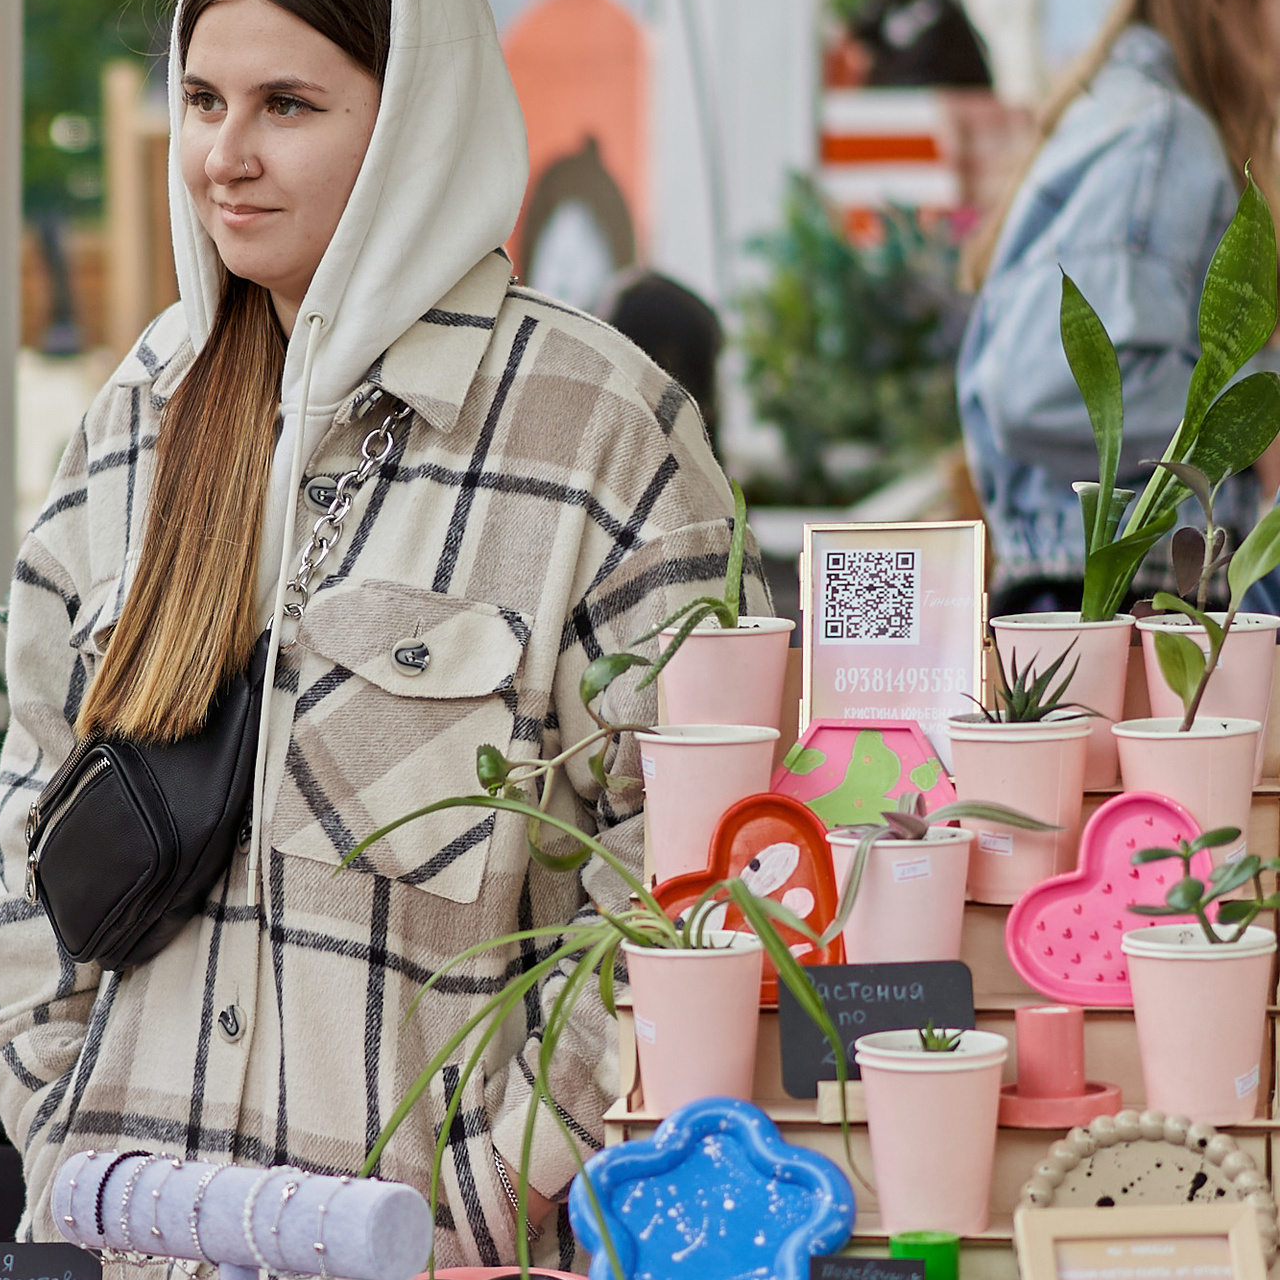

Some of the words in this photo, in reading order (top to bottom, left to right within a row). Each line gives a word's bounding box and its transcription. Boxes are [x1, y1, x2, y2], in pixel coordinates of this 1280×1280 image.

[834, 667, 968, 694] 89381495558
[843, 706, 900, 720] КРИСТИНА
[838, 1009, 868, 1026] по
